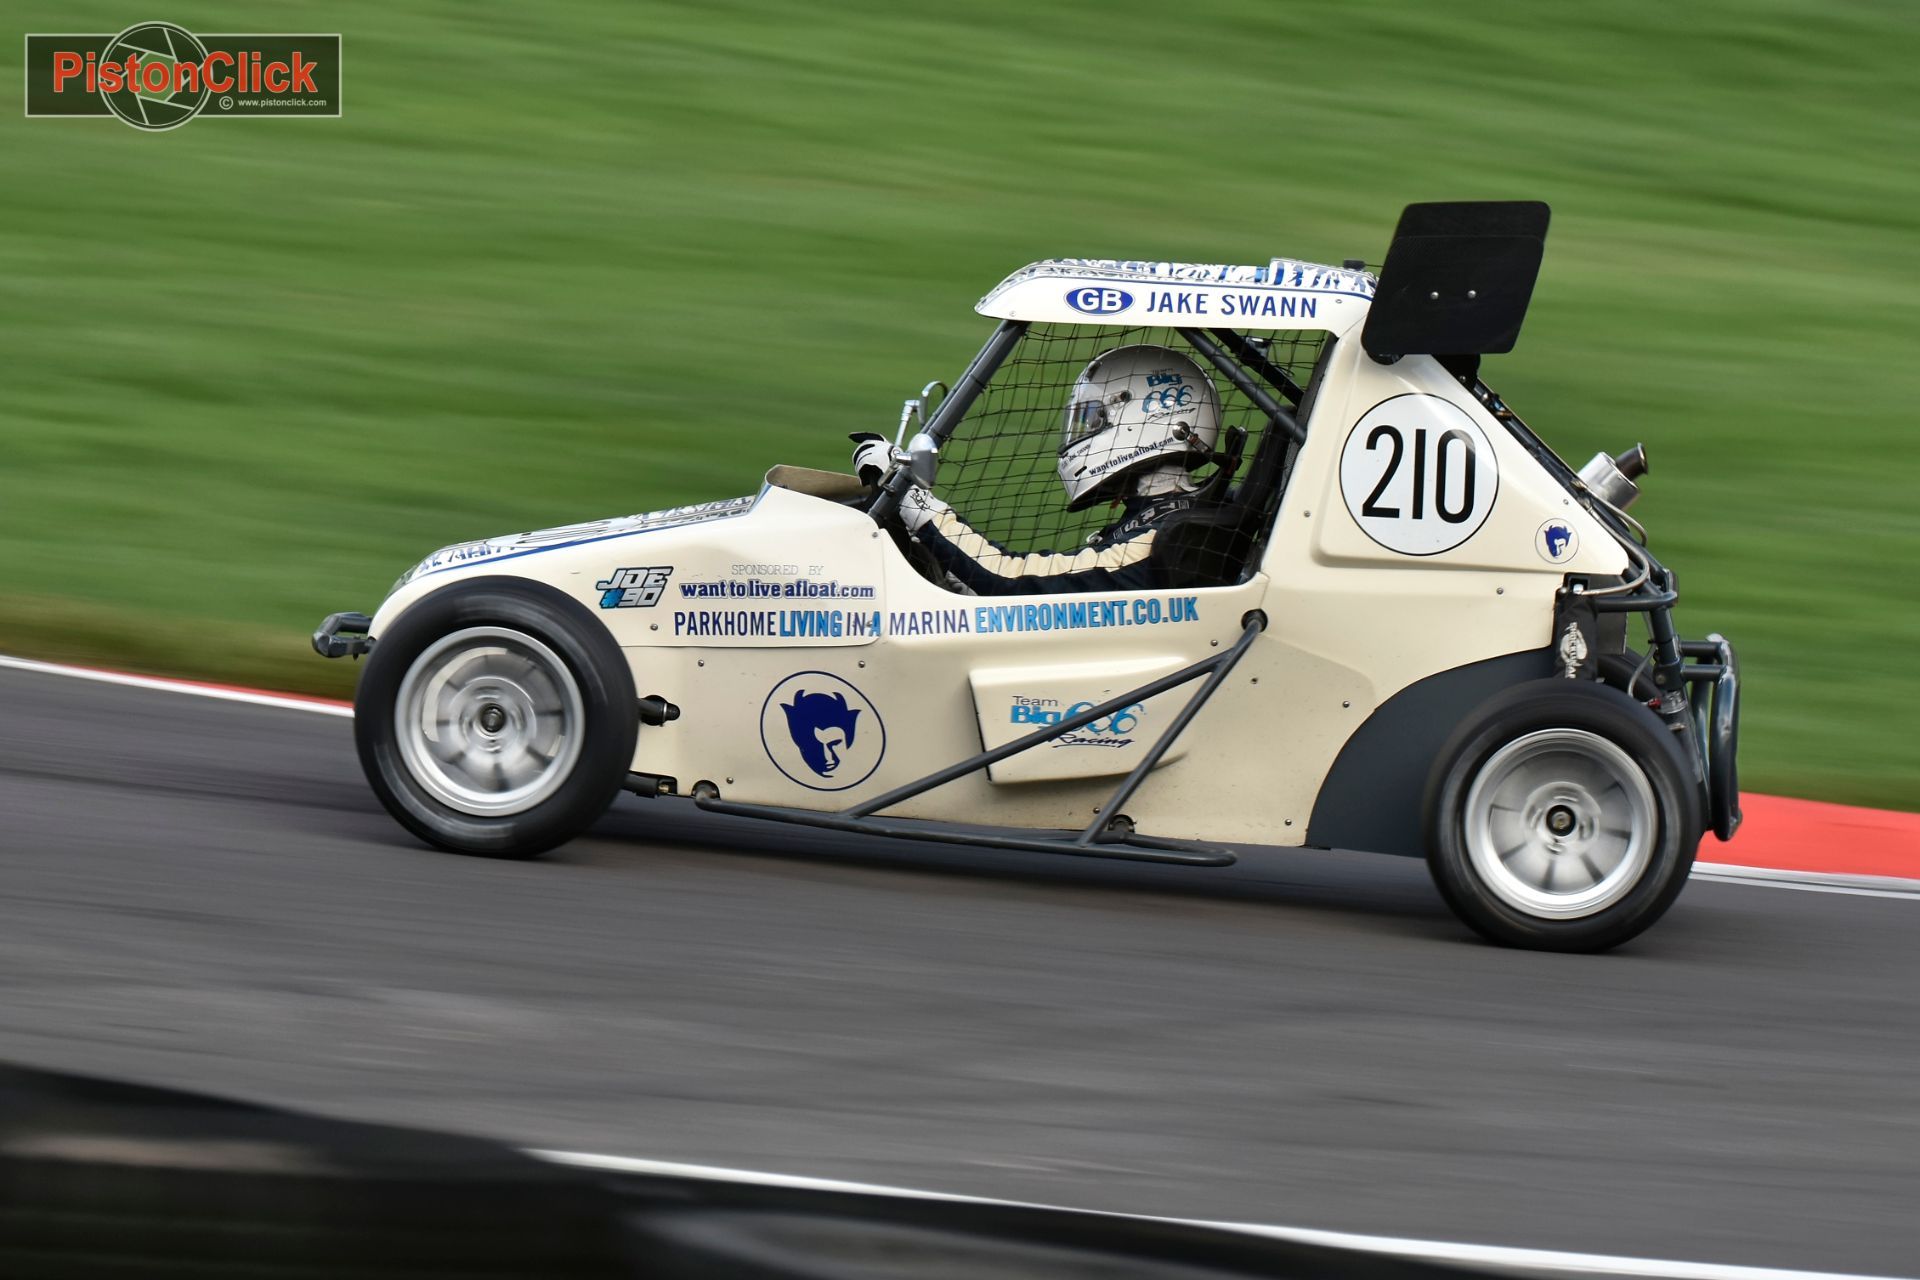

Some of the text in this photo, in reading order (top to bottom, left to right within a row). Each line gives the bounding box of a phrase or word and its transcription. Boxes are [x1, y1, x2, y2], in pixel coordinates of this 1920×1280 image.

[1076, 288, 1318, 319] GB JAKE SWANN
[1362, 424, 1476, 523] 210
[596, 566, 674, 590] JOE
[731, 564, 824, 576] SPONSORED BY
[785, 579, 874, 598] afloat.com
[674, 611, 777, 636] PARKHOME
[779, 610, 842, 637] LIVING
[889, 609, 970, 636] MARINA
[975, 596, 1199, 633] ENVIRONMENT.CO.UK
[1012, 696, 1058, 707] Team
[1010, 704, 1062, 728] Big
[1056, 732, 1135, 748] Racing
